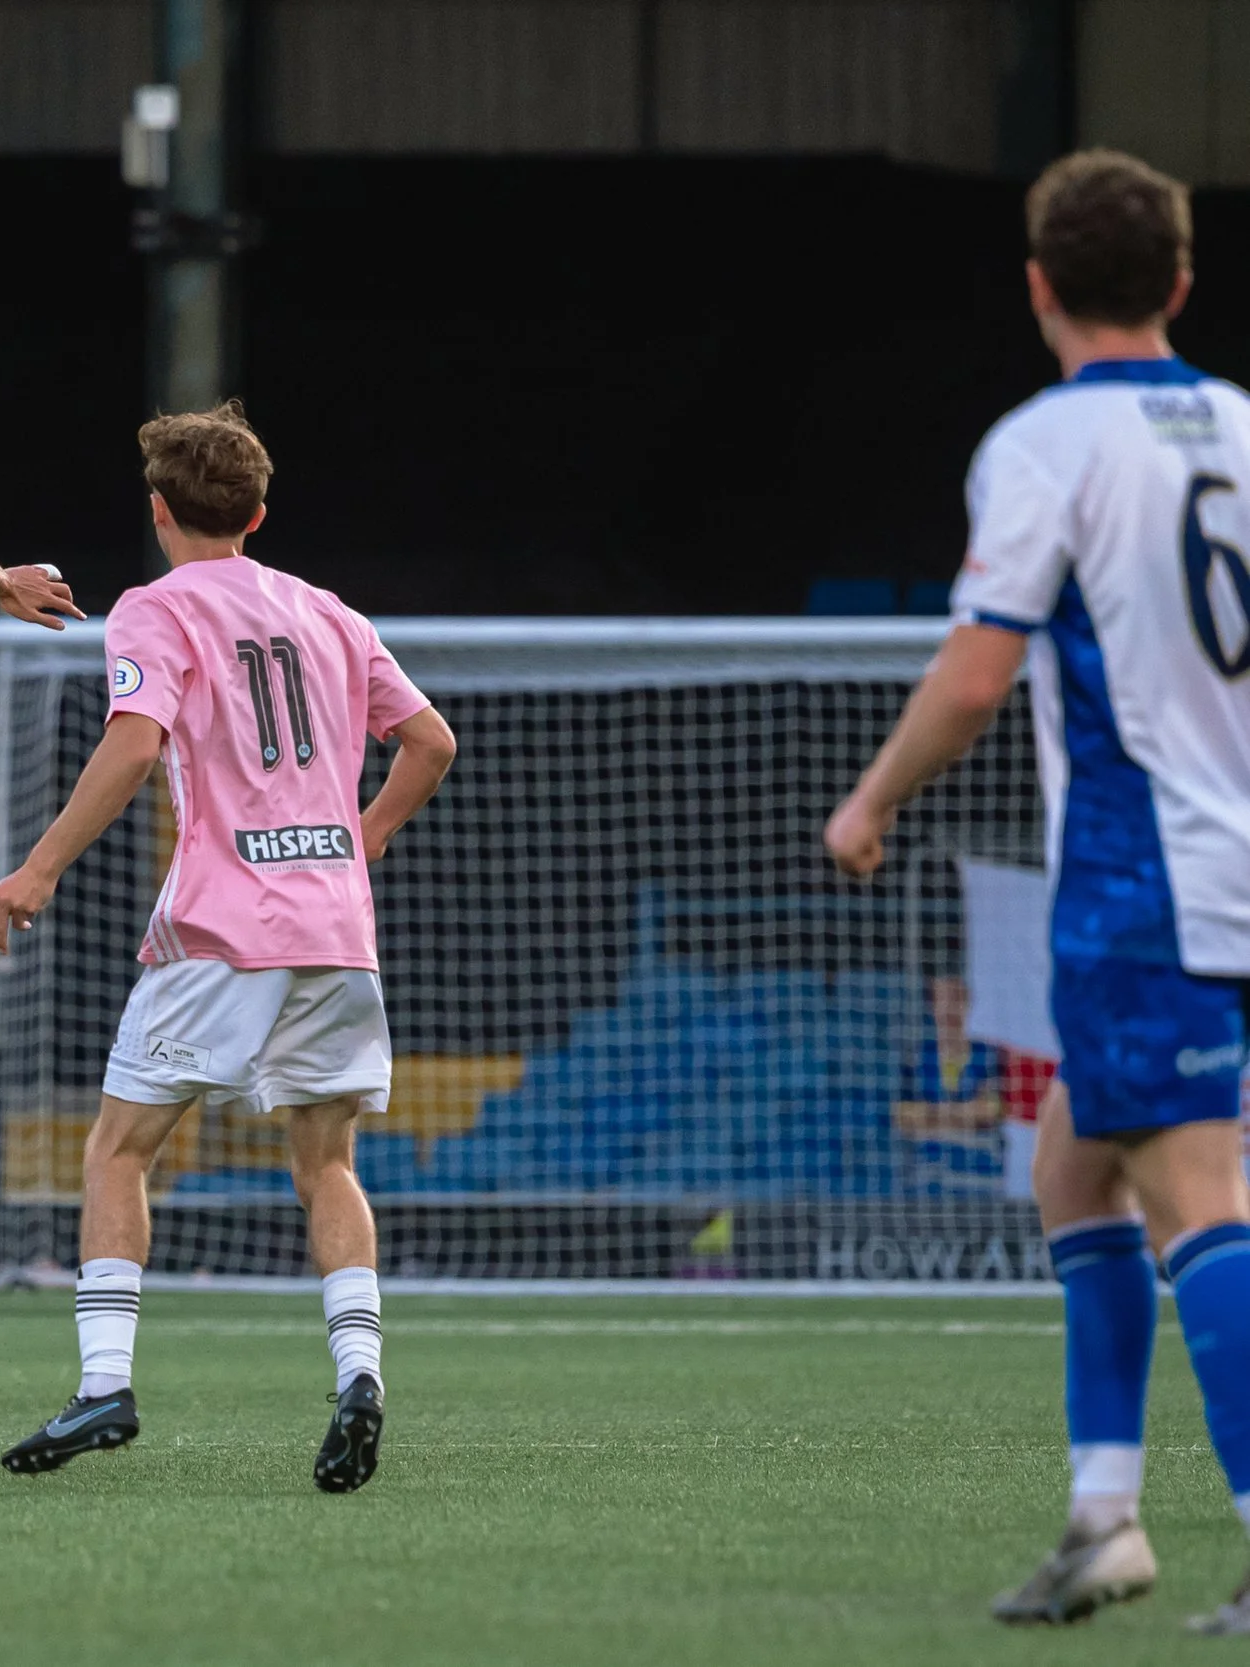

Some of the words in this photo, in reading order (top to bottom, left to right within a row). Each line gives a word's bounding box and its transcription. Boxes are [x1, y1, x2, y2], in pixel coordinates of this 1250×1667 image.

[1181, 469, 1250, 684] 6
[235, 636, 318, 773] 11
[246, 829, 346, 862] HiSPEC
